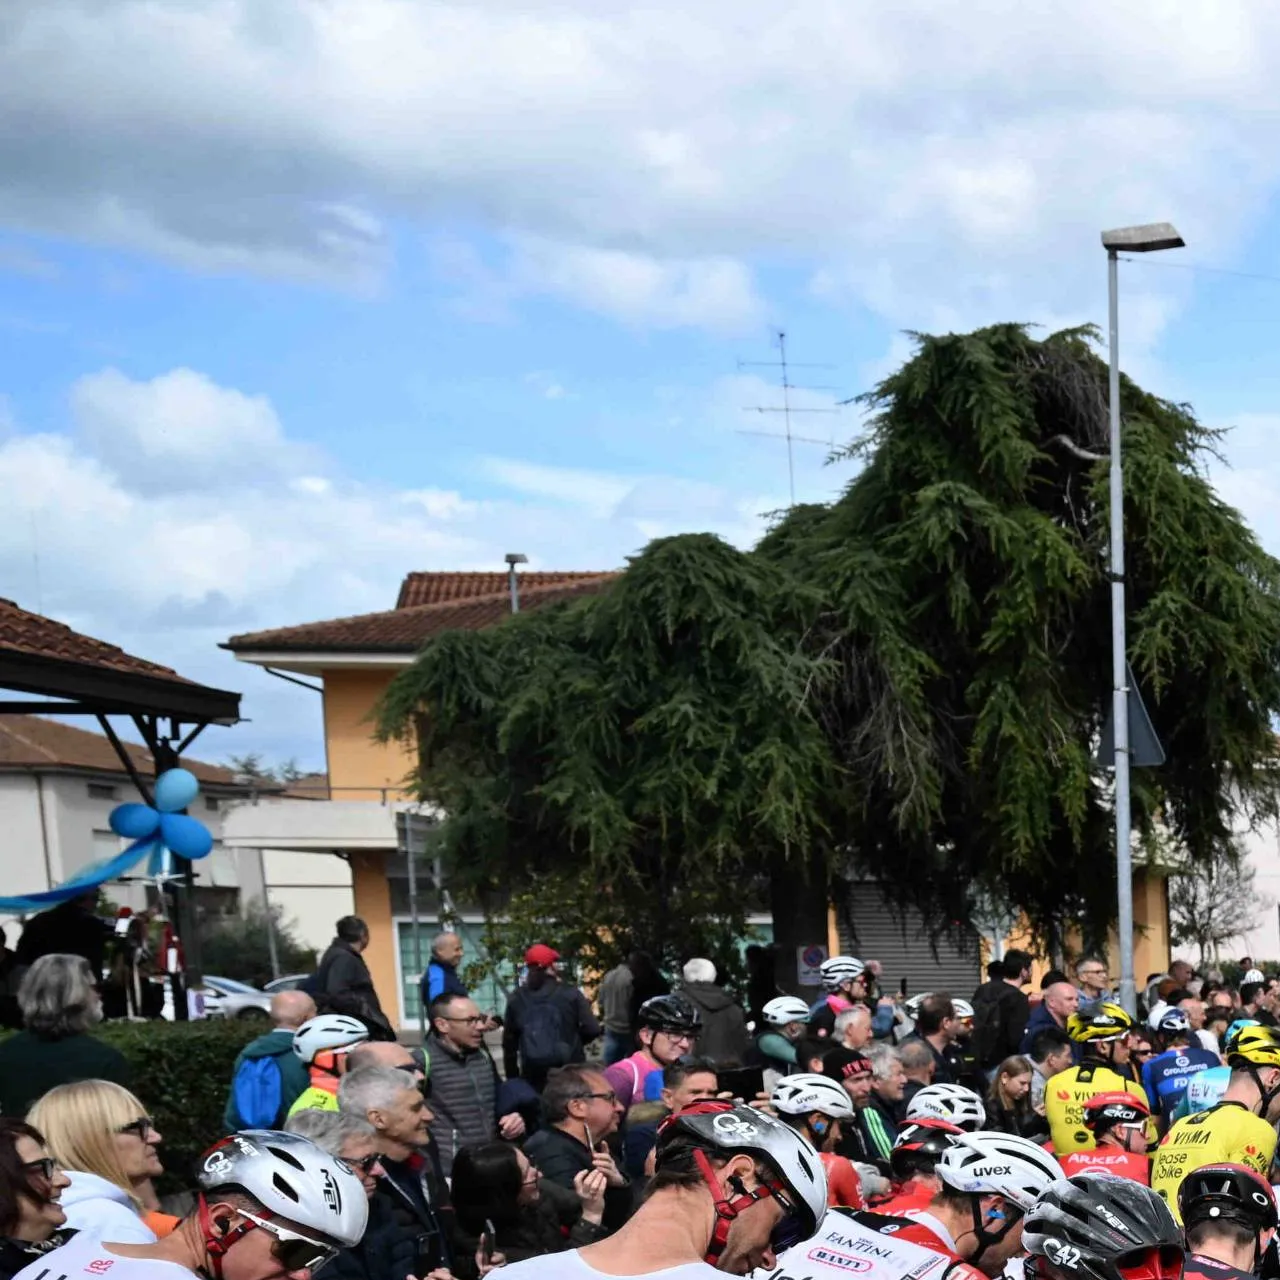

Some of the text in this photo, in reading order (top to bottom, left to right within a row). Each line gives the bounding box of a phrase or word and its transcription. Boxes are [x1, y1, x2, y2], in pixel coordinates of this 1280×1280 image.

[1164, 1062, 1208, 1077] Groupama
[1174, 1130, 1211, 1145] VISMA
[1068, 1153, 1129, 1165] ARKEA
[973, 1164, 1013, 1178] uvex
[320, 1168, 342, 1215] MET
[1096, 1204, 1130, 1234] MET
[1043, 1238, 1082, 1271] G42
